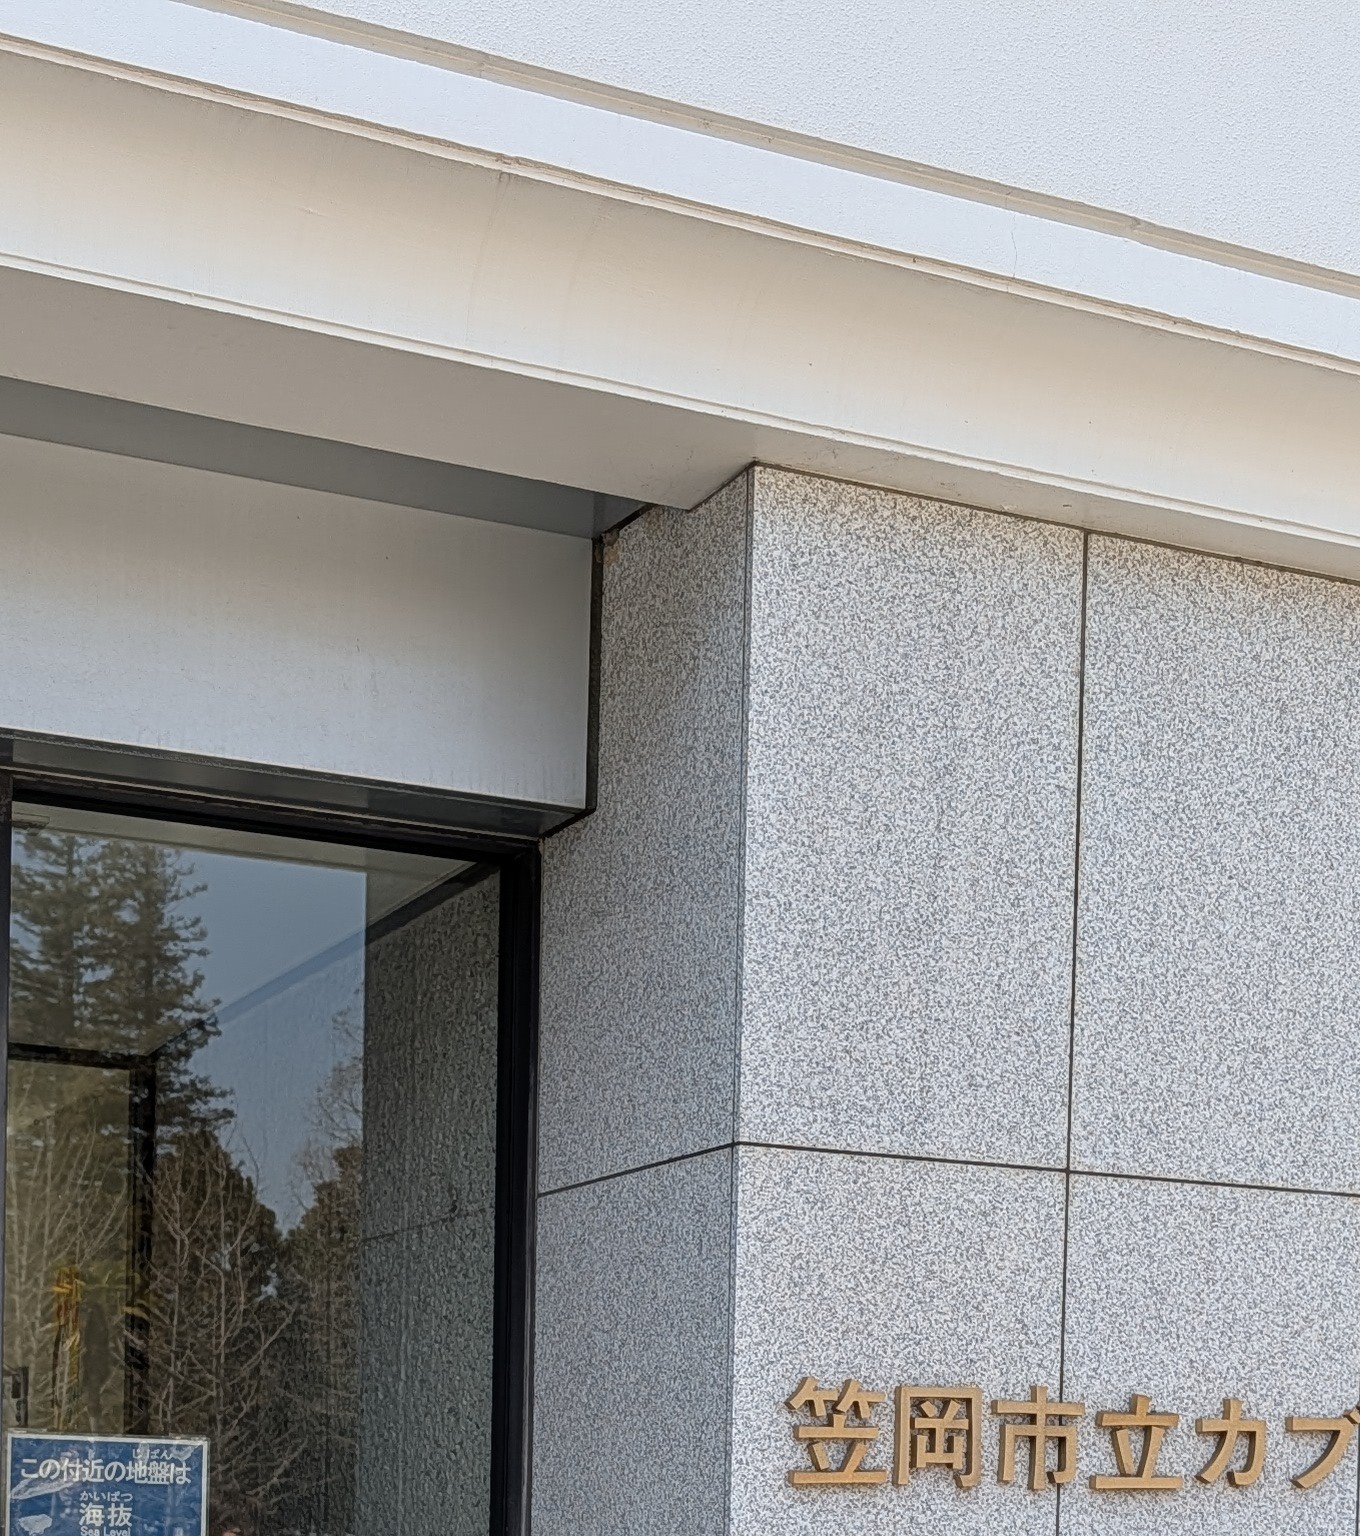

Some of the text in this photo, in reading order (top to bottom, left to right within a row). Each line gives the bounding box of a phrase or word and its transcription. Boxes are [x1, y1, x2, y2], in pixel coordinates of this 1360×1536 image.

[20, 1457, 192, 1485] この付近の地盤は
[79, 1503, 133, 1528] 海抜
